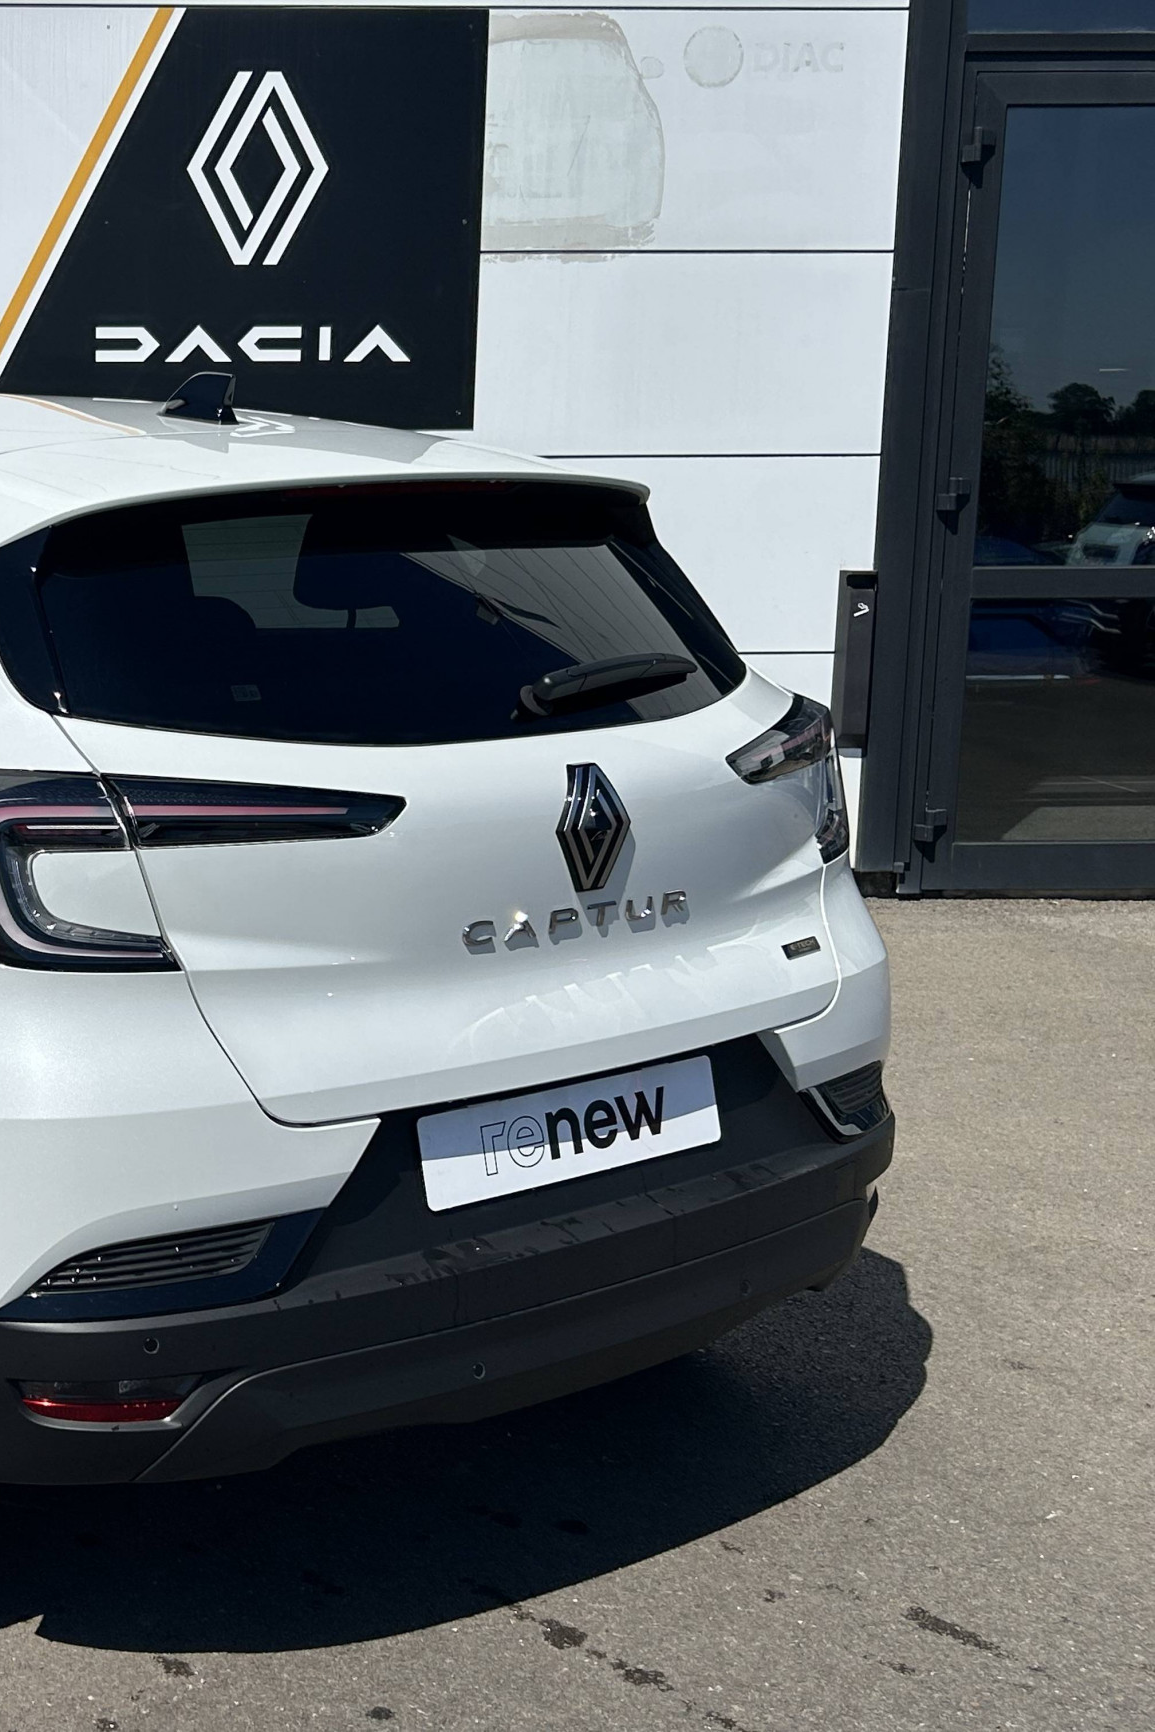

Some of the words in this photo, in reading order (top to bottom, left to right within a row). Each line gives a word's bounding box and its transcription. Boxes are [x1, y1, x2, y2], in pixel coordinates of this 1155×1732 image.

[94, 324, 412, 364] DACIA
[462, 889, 688, 948] CAPTUR
[480, 1085, 665, 1177] renew
